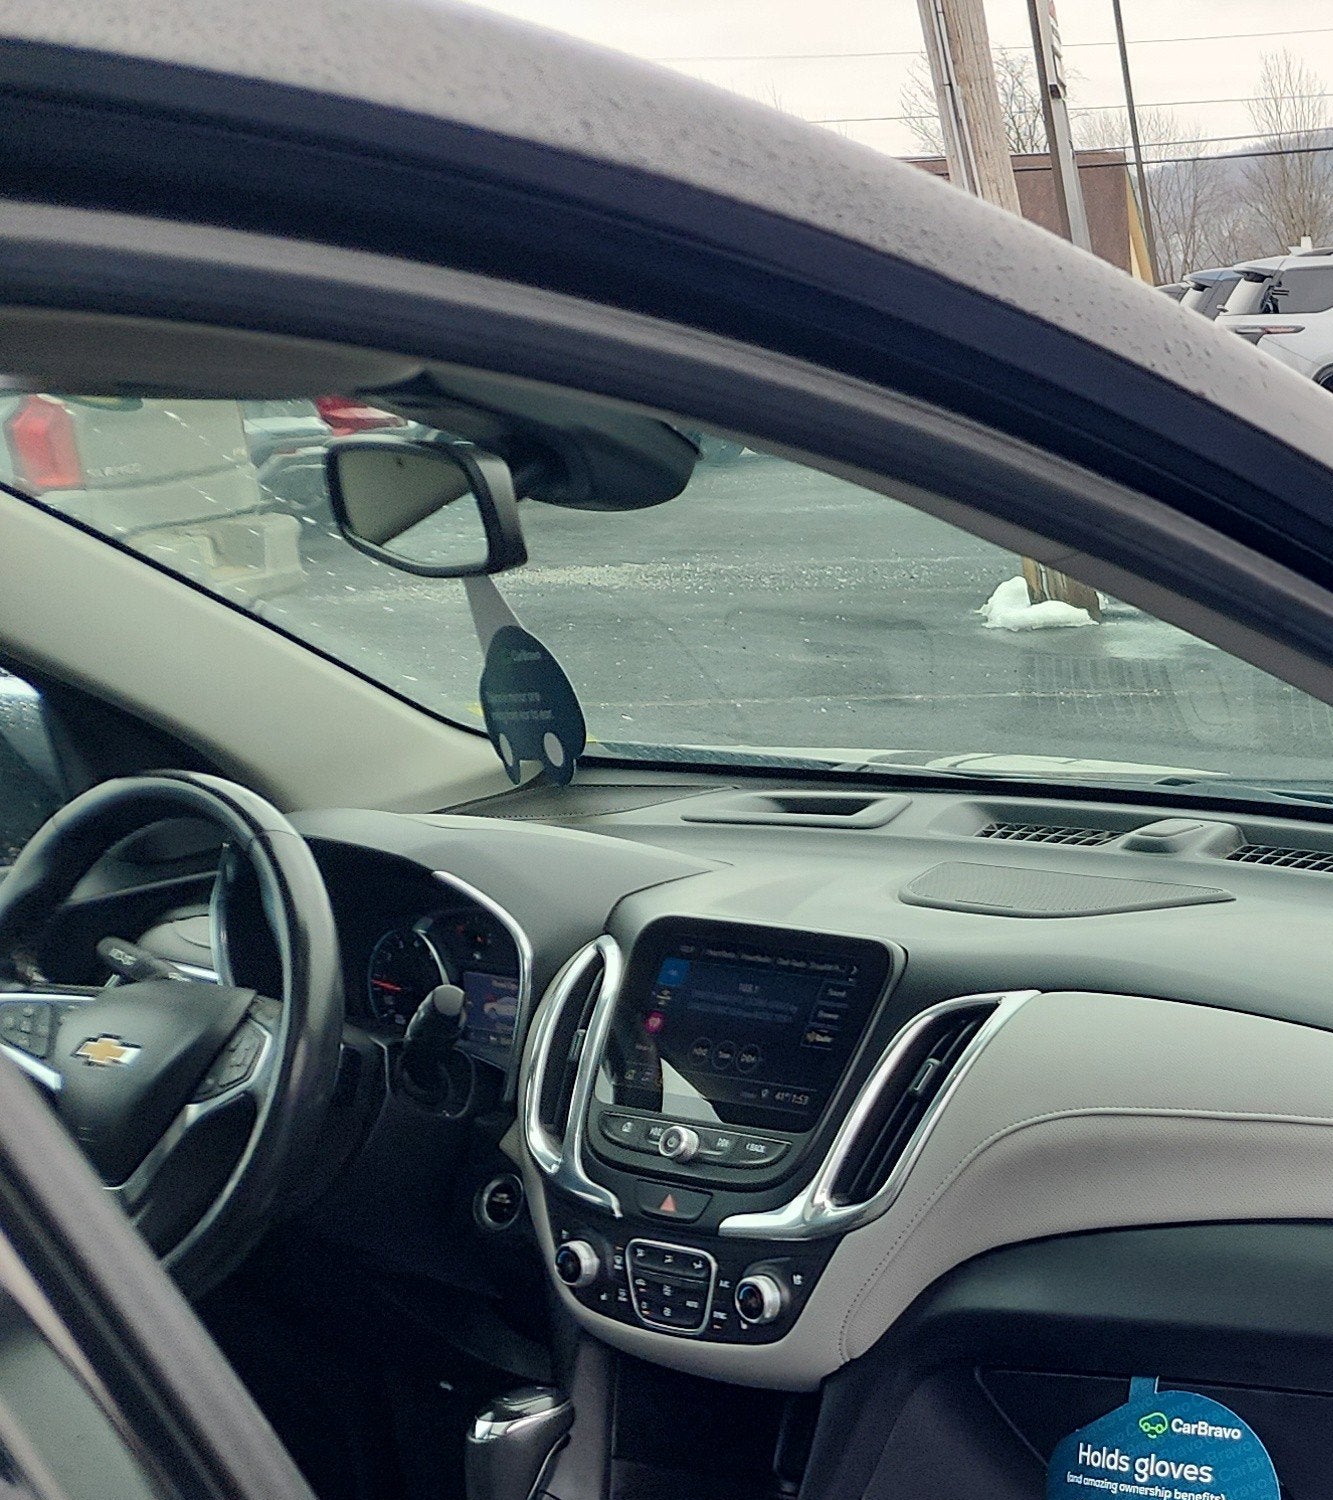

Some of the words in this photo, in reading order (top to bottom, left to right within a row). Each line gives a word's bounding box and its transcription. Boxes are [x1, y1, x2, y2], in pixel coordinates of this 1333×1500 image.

[1171, 1418, 1242, 1440] CarBravo
[1078, 1442, 1131, 1472] Holds
[1134, 1454, 1214, 1483] gloves
[1067, 1471, 1082, 1483] (and
[1083, 1478, 1118, 1494] amazing
[1119, 1483, 1172, 1500] ownership
